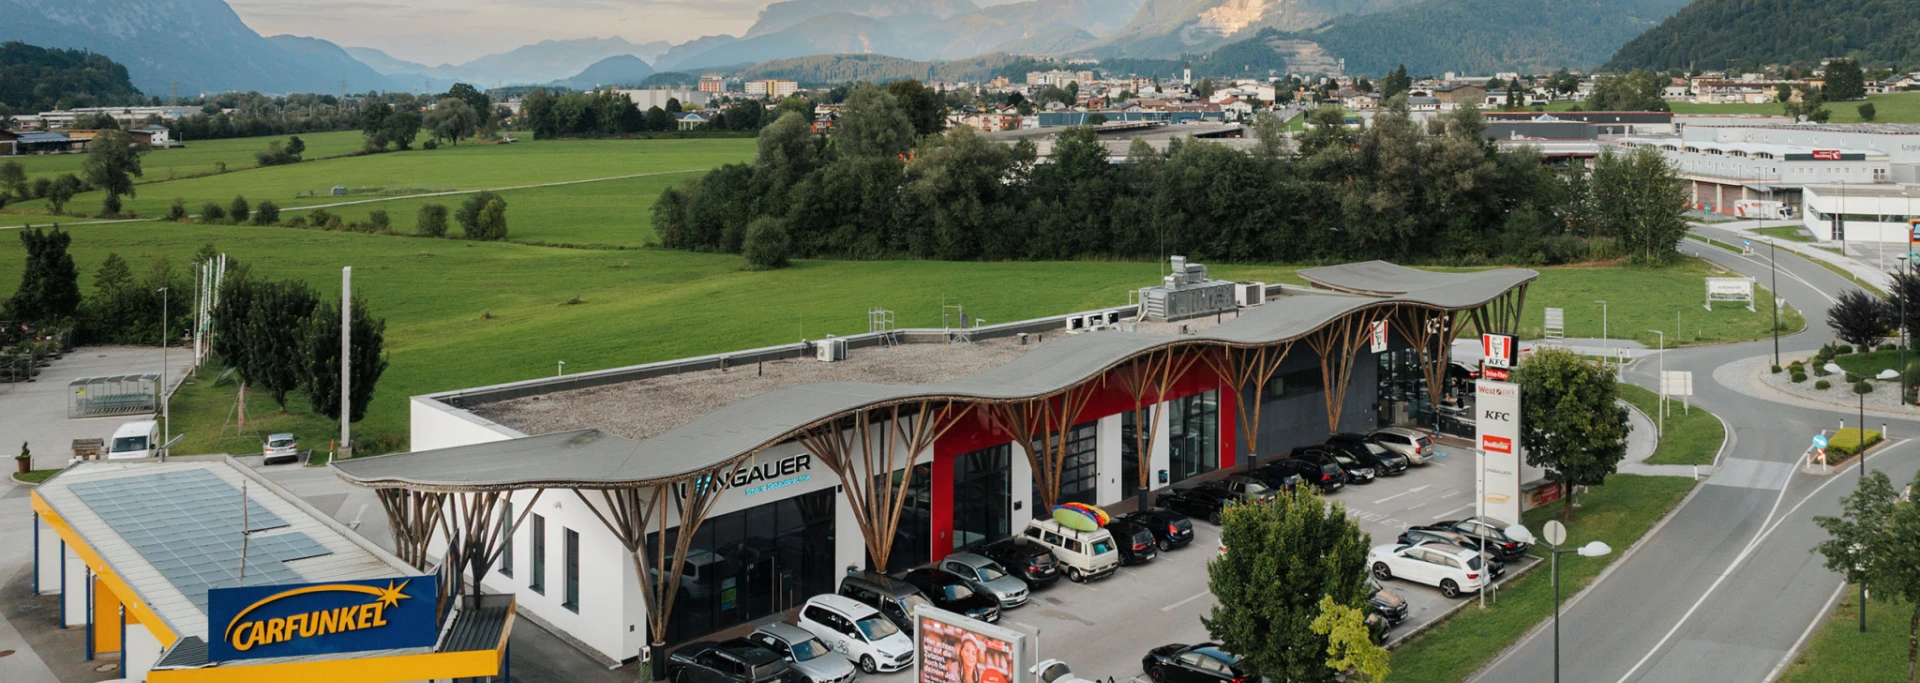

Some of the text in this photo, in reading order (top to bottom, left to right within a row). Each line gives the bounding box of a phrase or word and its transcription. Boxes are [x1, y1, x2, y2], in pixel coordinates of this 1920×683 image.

[1488, 358, 1506, 366] KFC
[1478, 385, 1516, 397] West park
[1484, 410, 1510, 421] KFC
[680, 453, 811, 500] LNGAUER
[231, 601, 387, 651] CARFUNKEL
